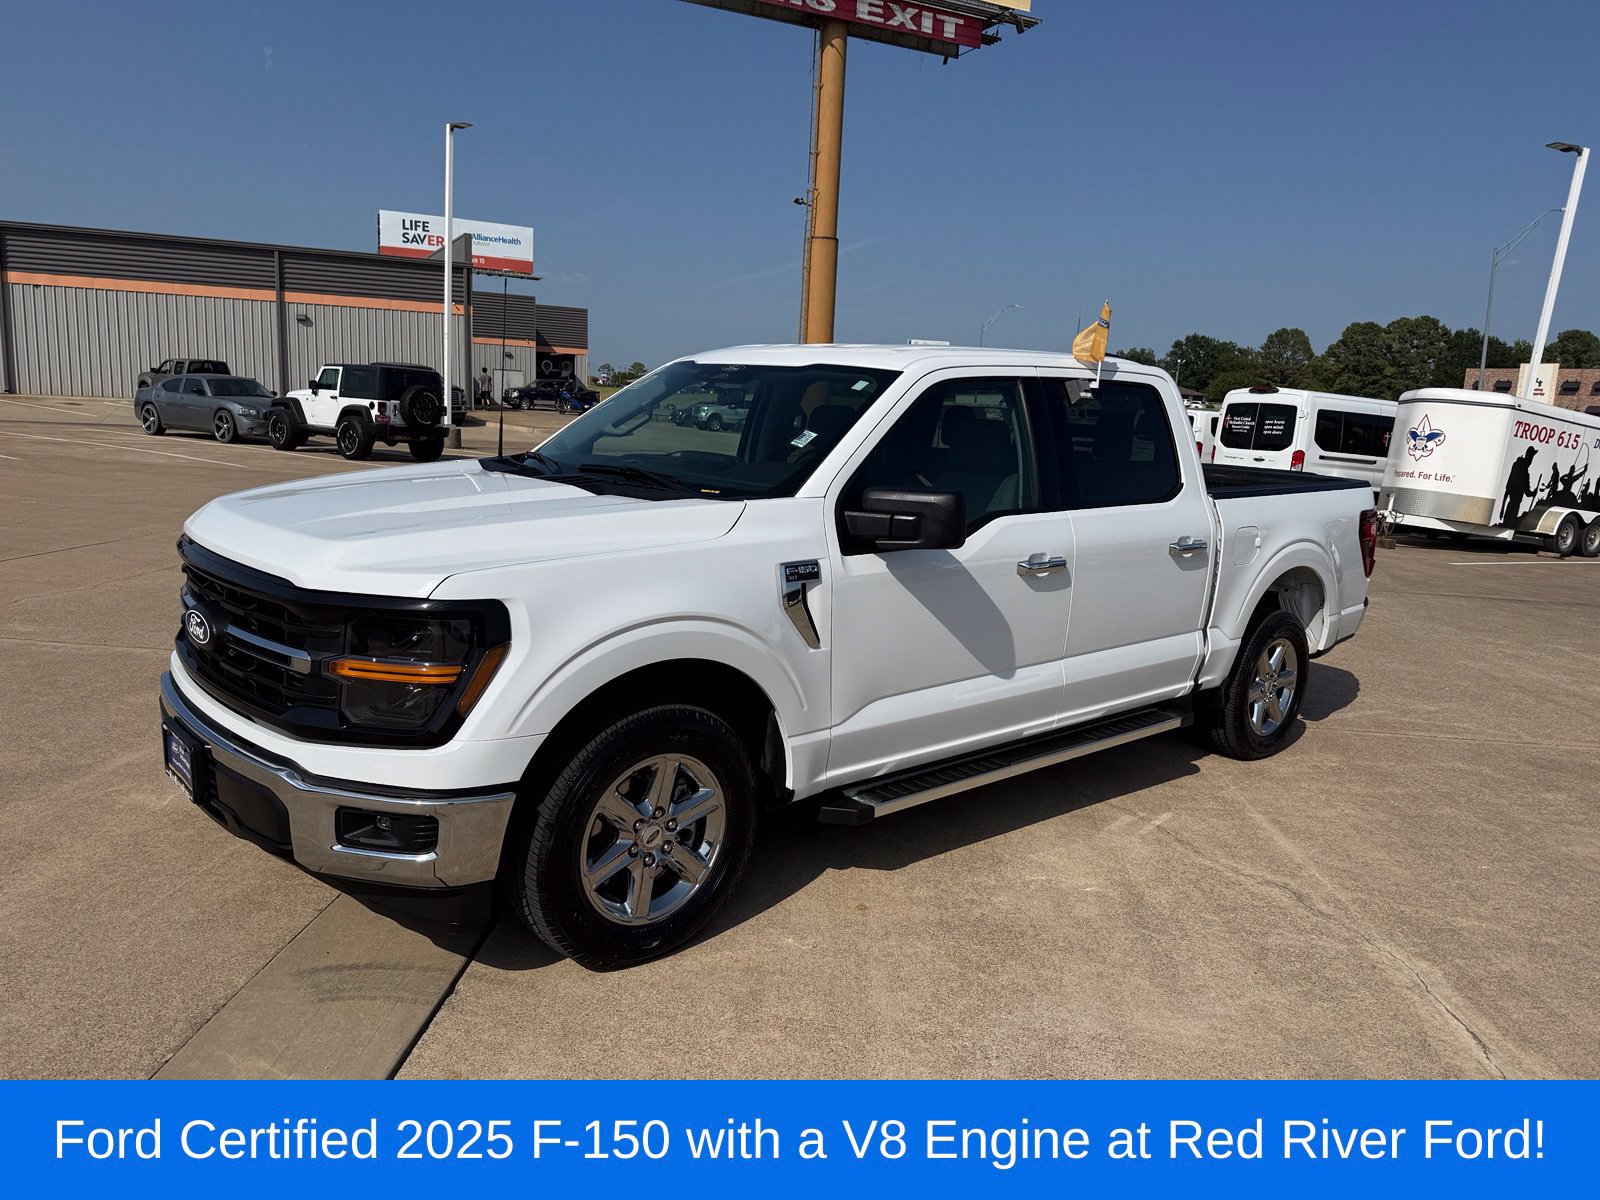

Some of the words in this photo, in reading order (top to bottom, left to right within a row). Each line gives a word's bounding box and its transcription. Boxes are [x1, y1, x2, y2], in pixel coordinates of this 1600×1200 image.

[856, 0, 965, 39] EXIT
[402, 219, 430, 233] LIFE
[402, 232, 445, 247] SAVER
[472, 233, 521, 245] AllianceHealth
[1514, 420, 1555, 444] TROOP
[1557, 431, 1581, 450] 615
[1418, 471, 1432, 480] For
[786, 565, 818, 575] F-150
[188, 612, 205, 640] Ford
